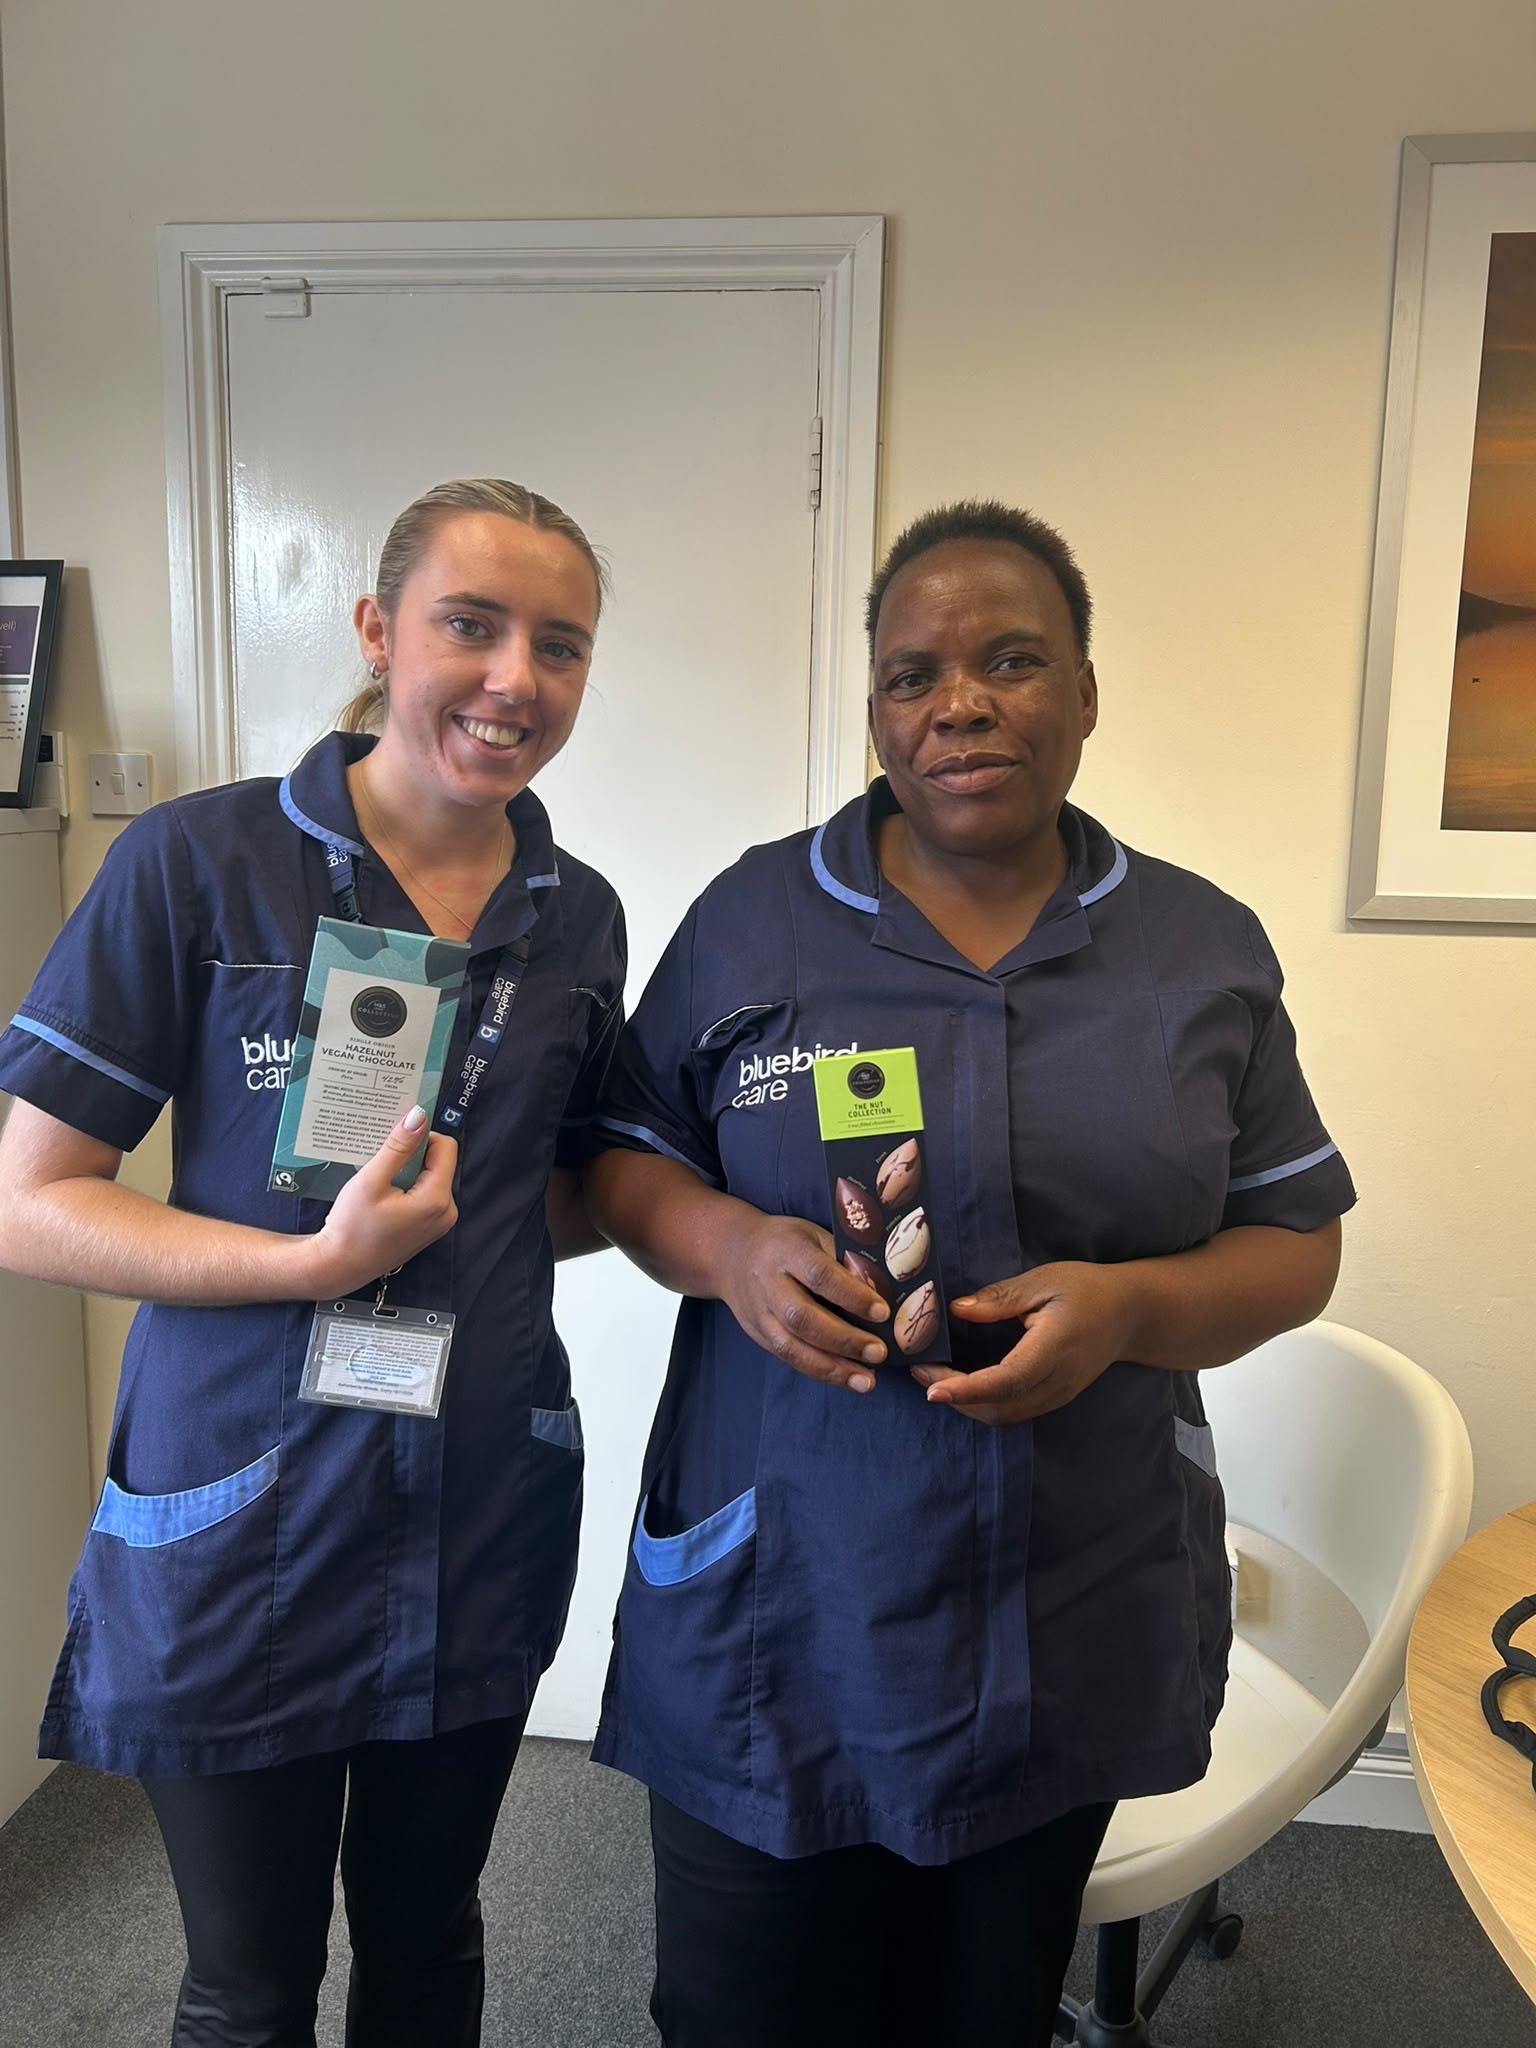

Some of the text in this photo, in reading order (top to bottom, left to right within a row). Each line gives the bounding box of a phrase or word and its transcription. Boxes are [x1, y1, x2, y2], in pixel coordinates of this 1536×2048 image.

[491, 977, 505, 999] care
[493, 980, 516, 1025] bluebird
[322, 1048, 416, 1070] VEGAN CHOCOLATE
[346, 1045, 396, 1059] HAZELNUT
[461, 1054, 477, 1080] care
[458, 1058, 488, 1108] bluebird
[732, 1079, 788, 1109] care
[848, 1107, 892, 1118] COLLECTION
